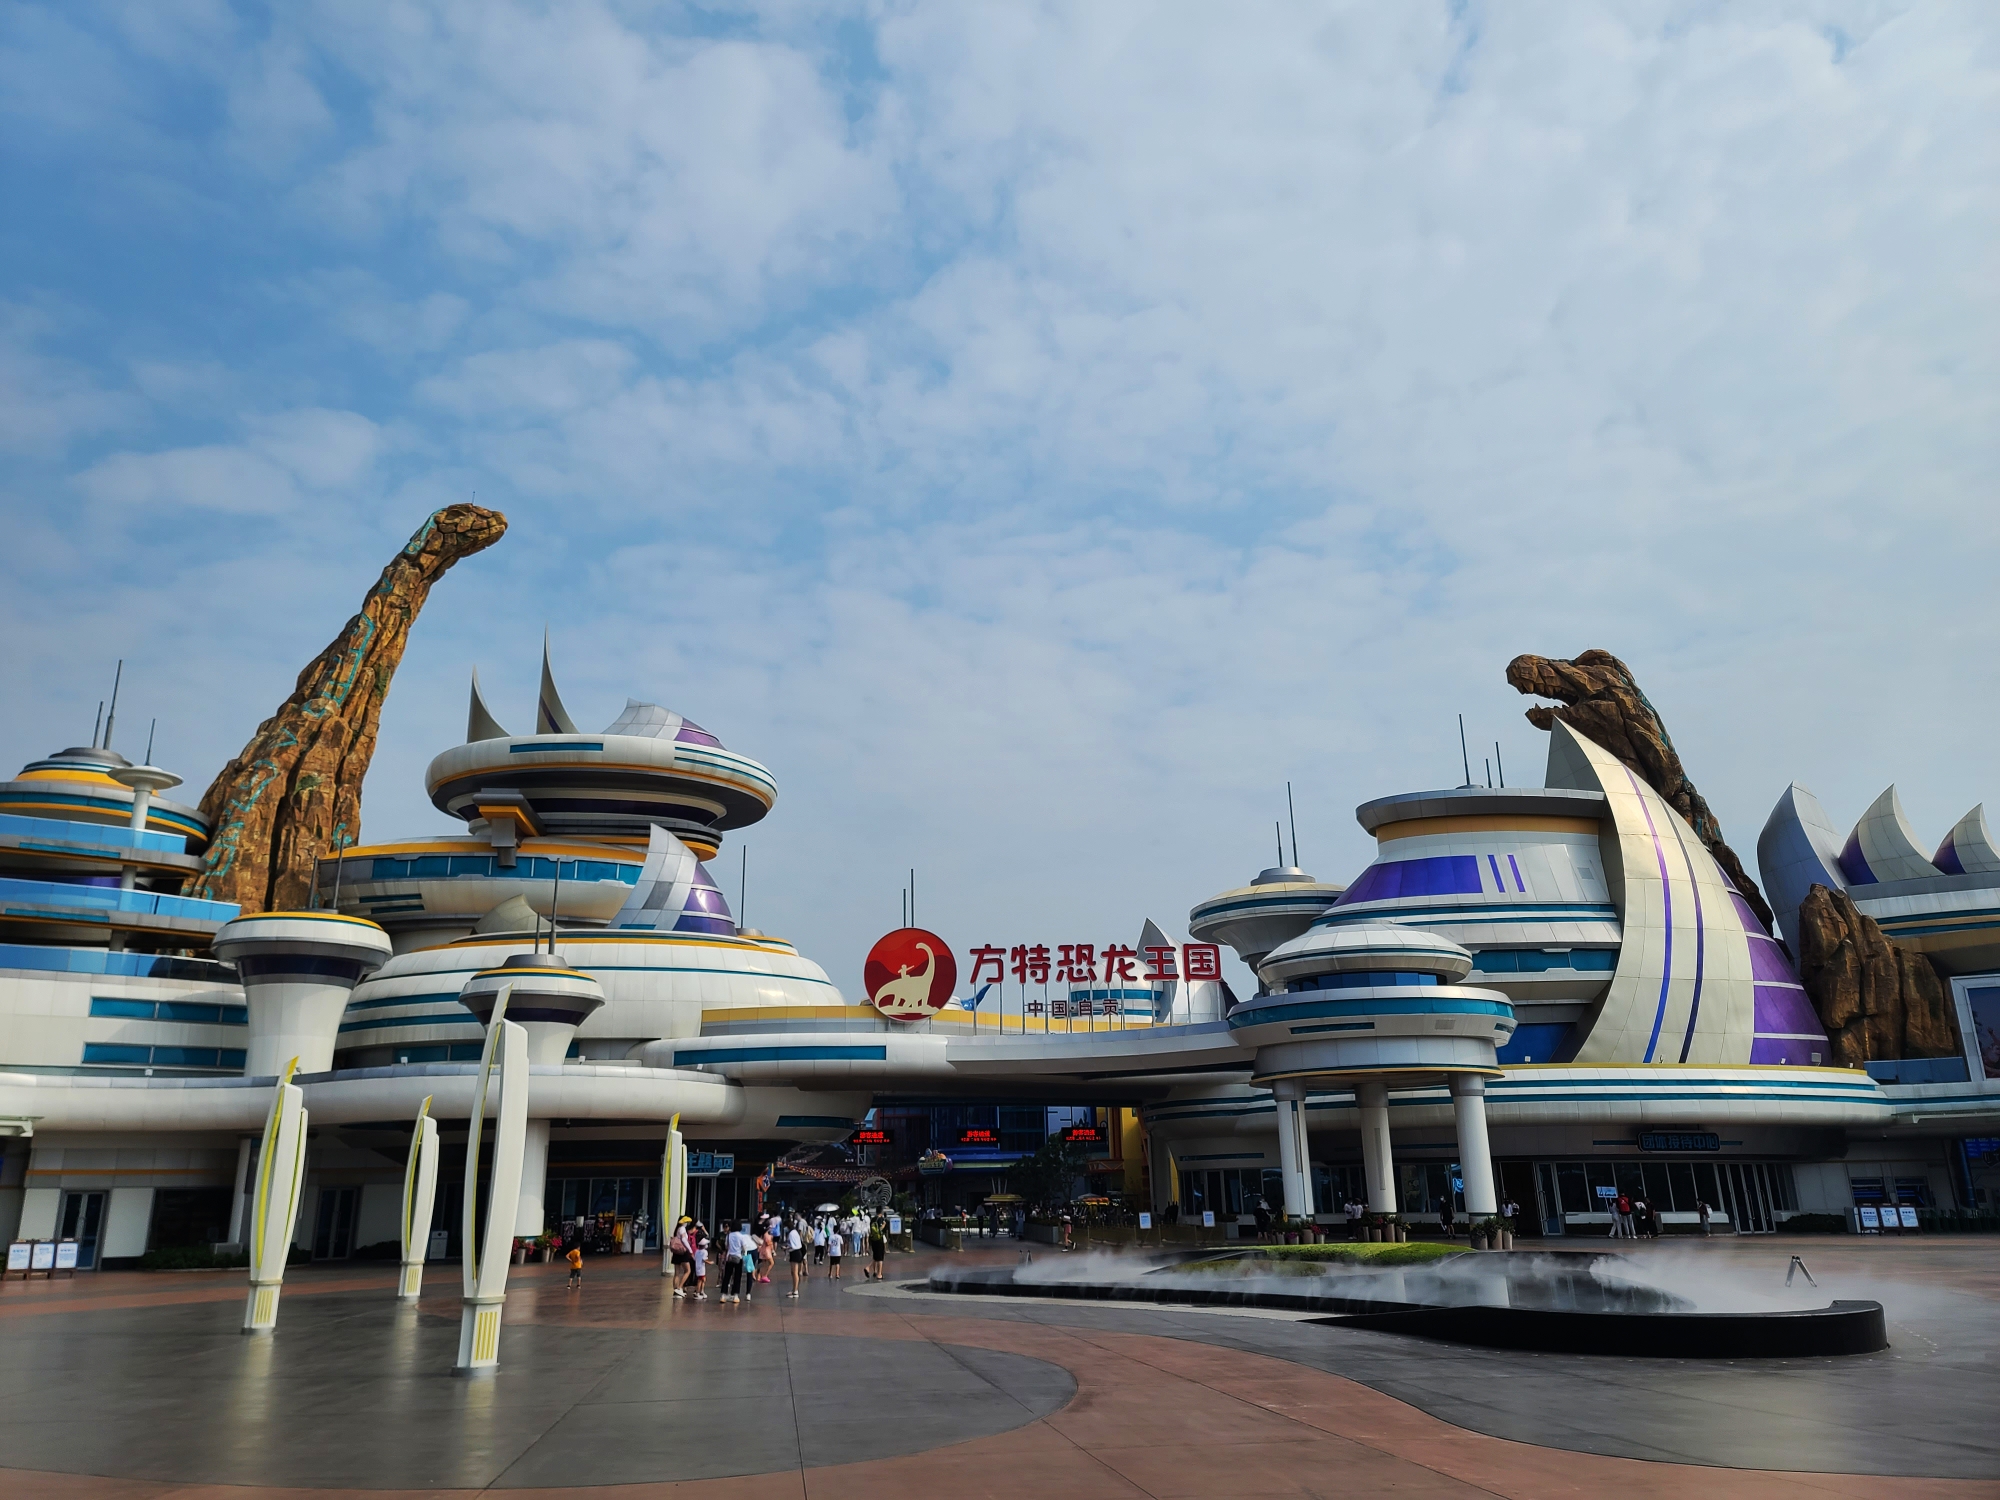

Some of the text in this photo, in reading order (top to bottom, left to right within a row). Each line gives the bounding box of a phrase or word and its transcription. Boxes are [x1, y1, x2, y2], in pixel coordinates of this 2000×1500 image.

[969, 943, 1222, 984] 方特恐龙王国
[1028, 998, 1119, 1018] 中国·自贡
[1642, 1134, 1719, 1150] 团体接待中心
